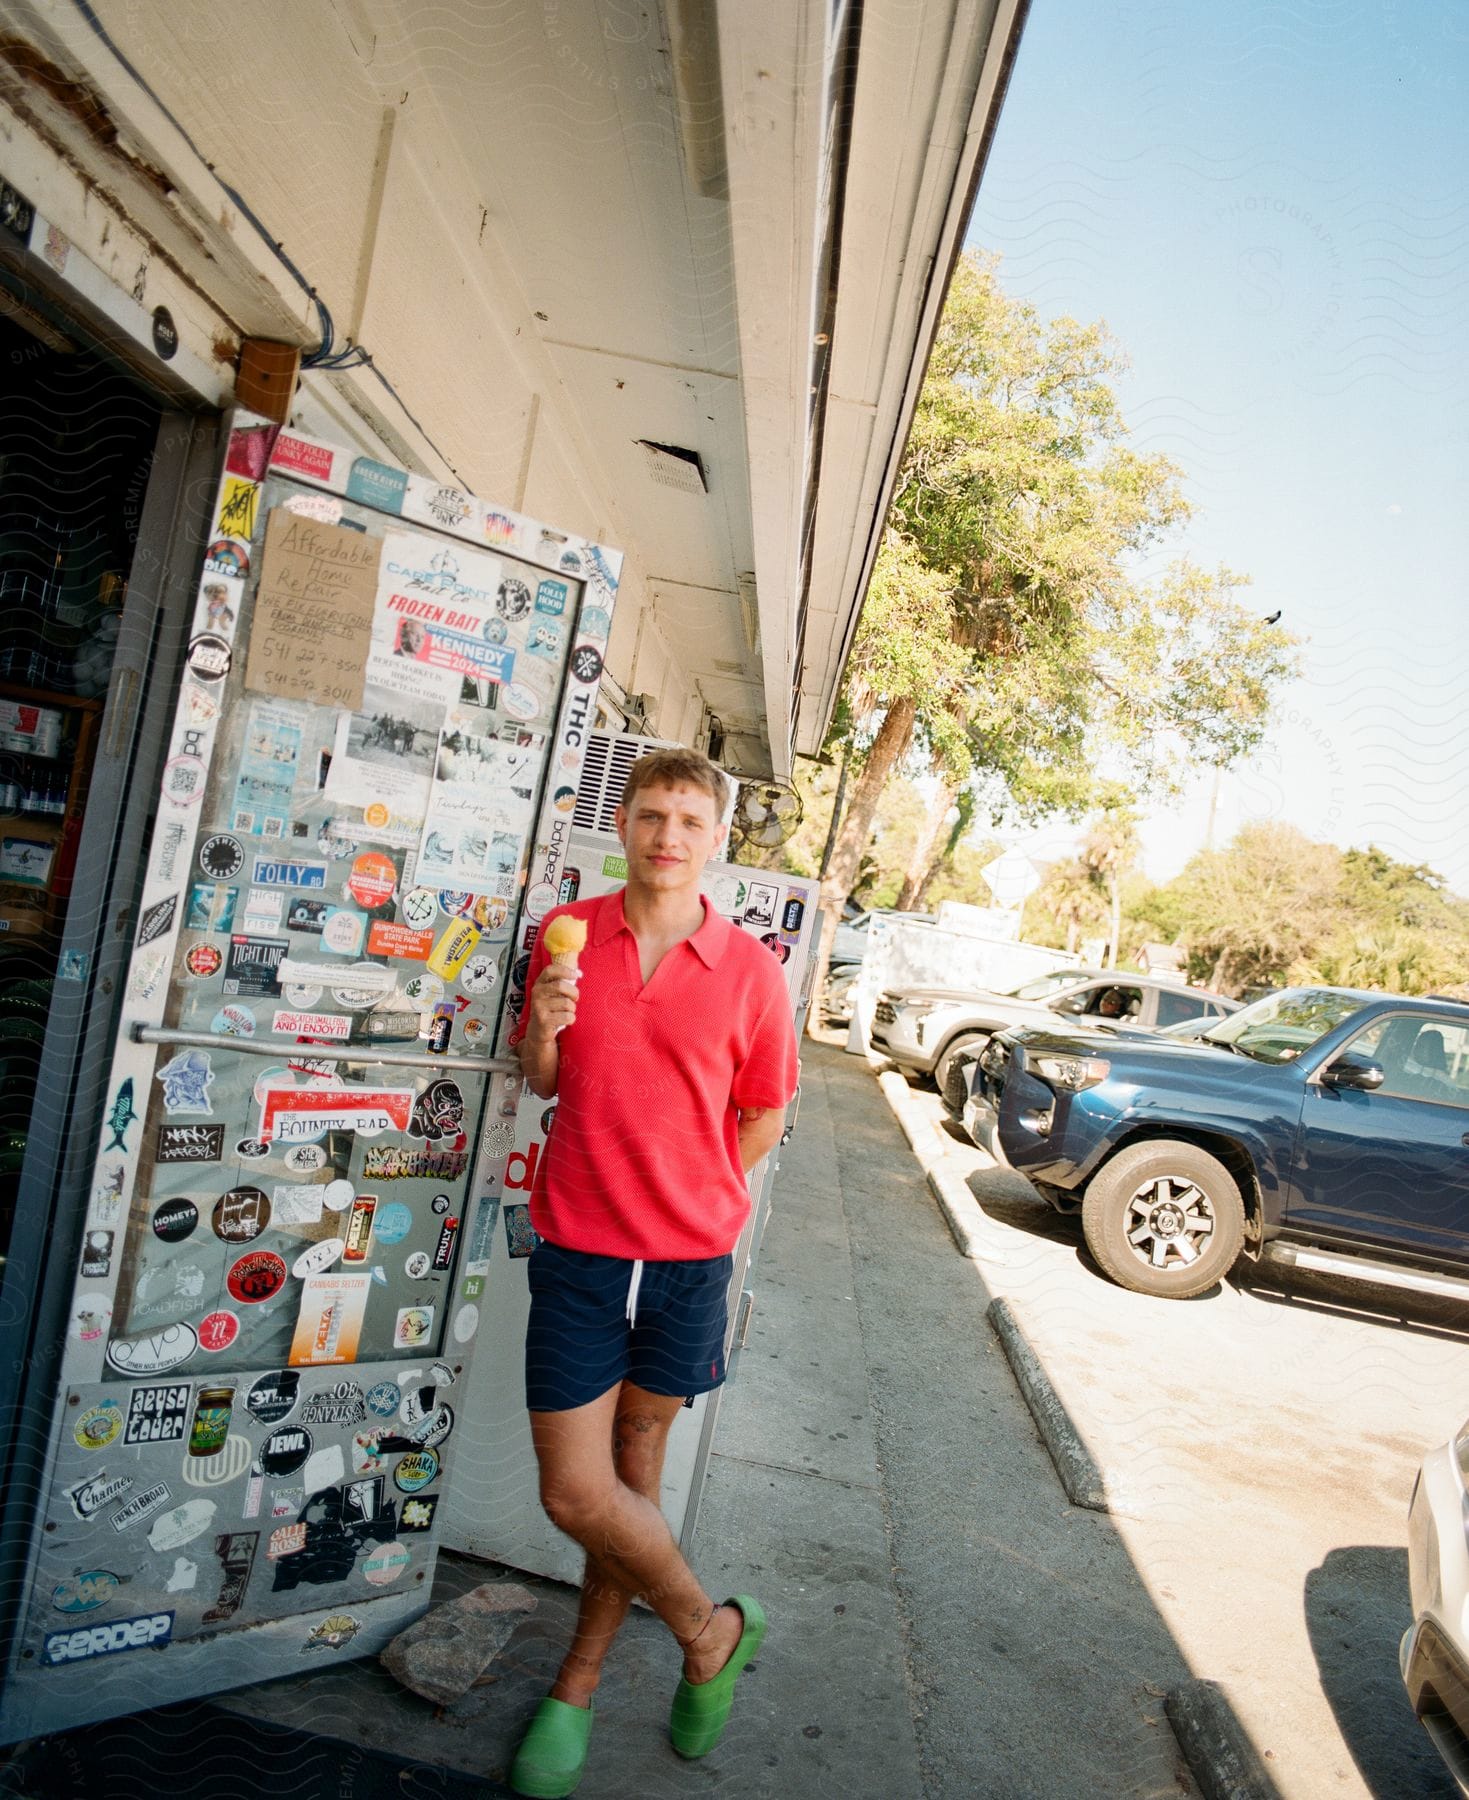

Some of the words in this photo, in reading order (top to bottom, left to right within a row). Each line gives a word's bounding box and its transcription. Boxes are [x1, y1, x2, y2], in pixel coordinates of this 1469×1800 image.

[278, 435, 300, 450] MAKE
[302, 443, 329, 459] FOLLY
[304, 454, 330, 470] AGAIN
[438, 488, 465, 504] KEEP
[431, 507, 464, 527] FUNKY
[278, 521, 375, 564] Affordable
[307, 559, 353, 584] Home
[276, 567, 341, 599] Repair
[440, 579, 490, 599] POINT
[539, 584, 566, 601] FOLLY
[538, 595, 563, 611] HOOD
[387, 594, 445, 622] FROZEN
[445, 611, 481, 633] BAIT
[263, 637, 291, 660] 541
[430, 634, 507, 666] KENNEDY
[400, 662, 433, 677] MARKET
[450, 656, 482, 675] 2024
[264, 671, 288, 685] 541
[322, 685, 353, 700] 3011
[400, 682, 420, 695] TEAM
[565, 693, 590, 748] THC
[204, 834, 241, 858] NOTHING
[257, 863, 306, 884] FOLLY
[310, 877, 322, 888] RD
[250, 889, 282, 902] HIGH
[142, 903, 170, 941] CAROLINA
[787, 902, 800, 929] DELTA
[373, 922, 413, 937] GUNPOWDER
[413, 930, 433, 940] FALLS
[384, 932, 404, 943] STATE
[404, 936, 421, 945] PARK
[232, 943, 263, 966] TIGHT
[263, 947, 285, 966] LINE
[444, 935, 463, 967] TWISTED
[460, 926, 473, 941] TEA
[275, 1021, 297, 1032] AND
[304, 1024, 335, 1036] ENJOY
[336, 1026, 348, 1038] IT!
[283, 1112, 296, 1121] THE
[154, 1208, 198, 1227] HOMEYS
[348, 1207, 366, 1250] DELTA
[436, 1228, 453, 1265] TRULY
[309, 1279, 339, 1289] CANNABIS
[340, 1279, 366, 1289] SELTZER
[466, 1281, 479, 1294] hi
[315, 1306, 334, 1351] DELTA
[126, 1360, 144, 1370] OTHER
[144, 1362, 157, 1370] NICE
[157, 1357, 178, 1369] PEOPLE
[303, 1405, 353, 1424] STRANGE
[268, 1433, 305, 1454] JEWL
[402, 1457, 434, 1474] SHAKA
[113, 1503, 141, 1527] FRENCH
[139, 1485, 166, 1508] BROAD
[270, 1536, 306, 1553] ROSE
